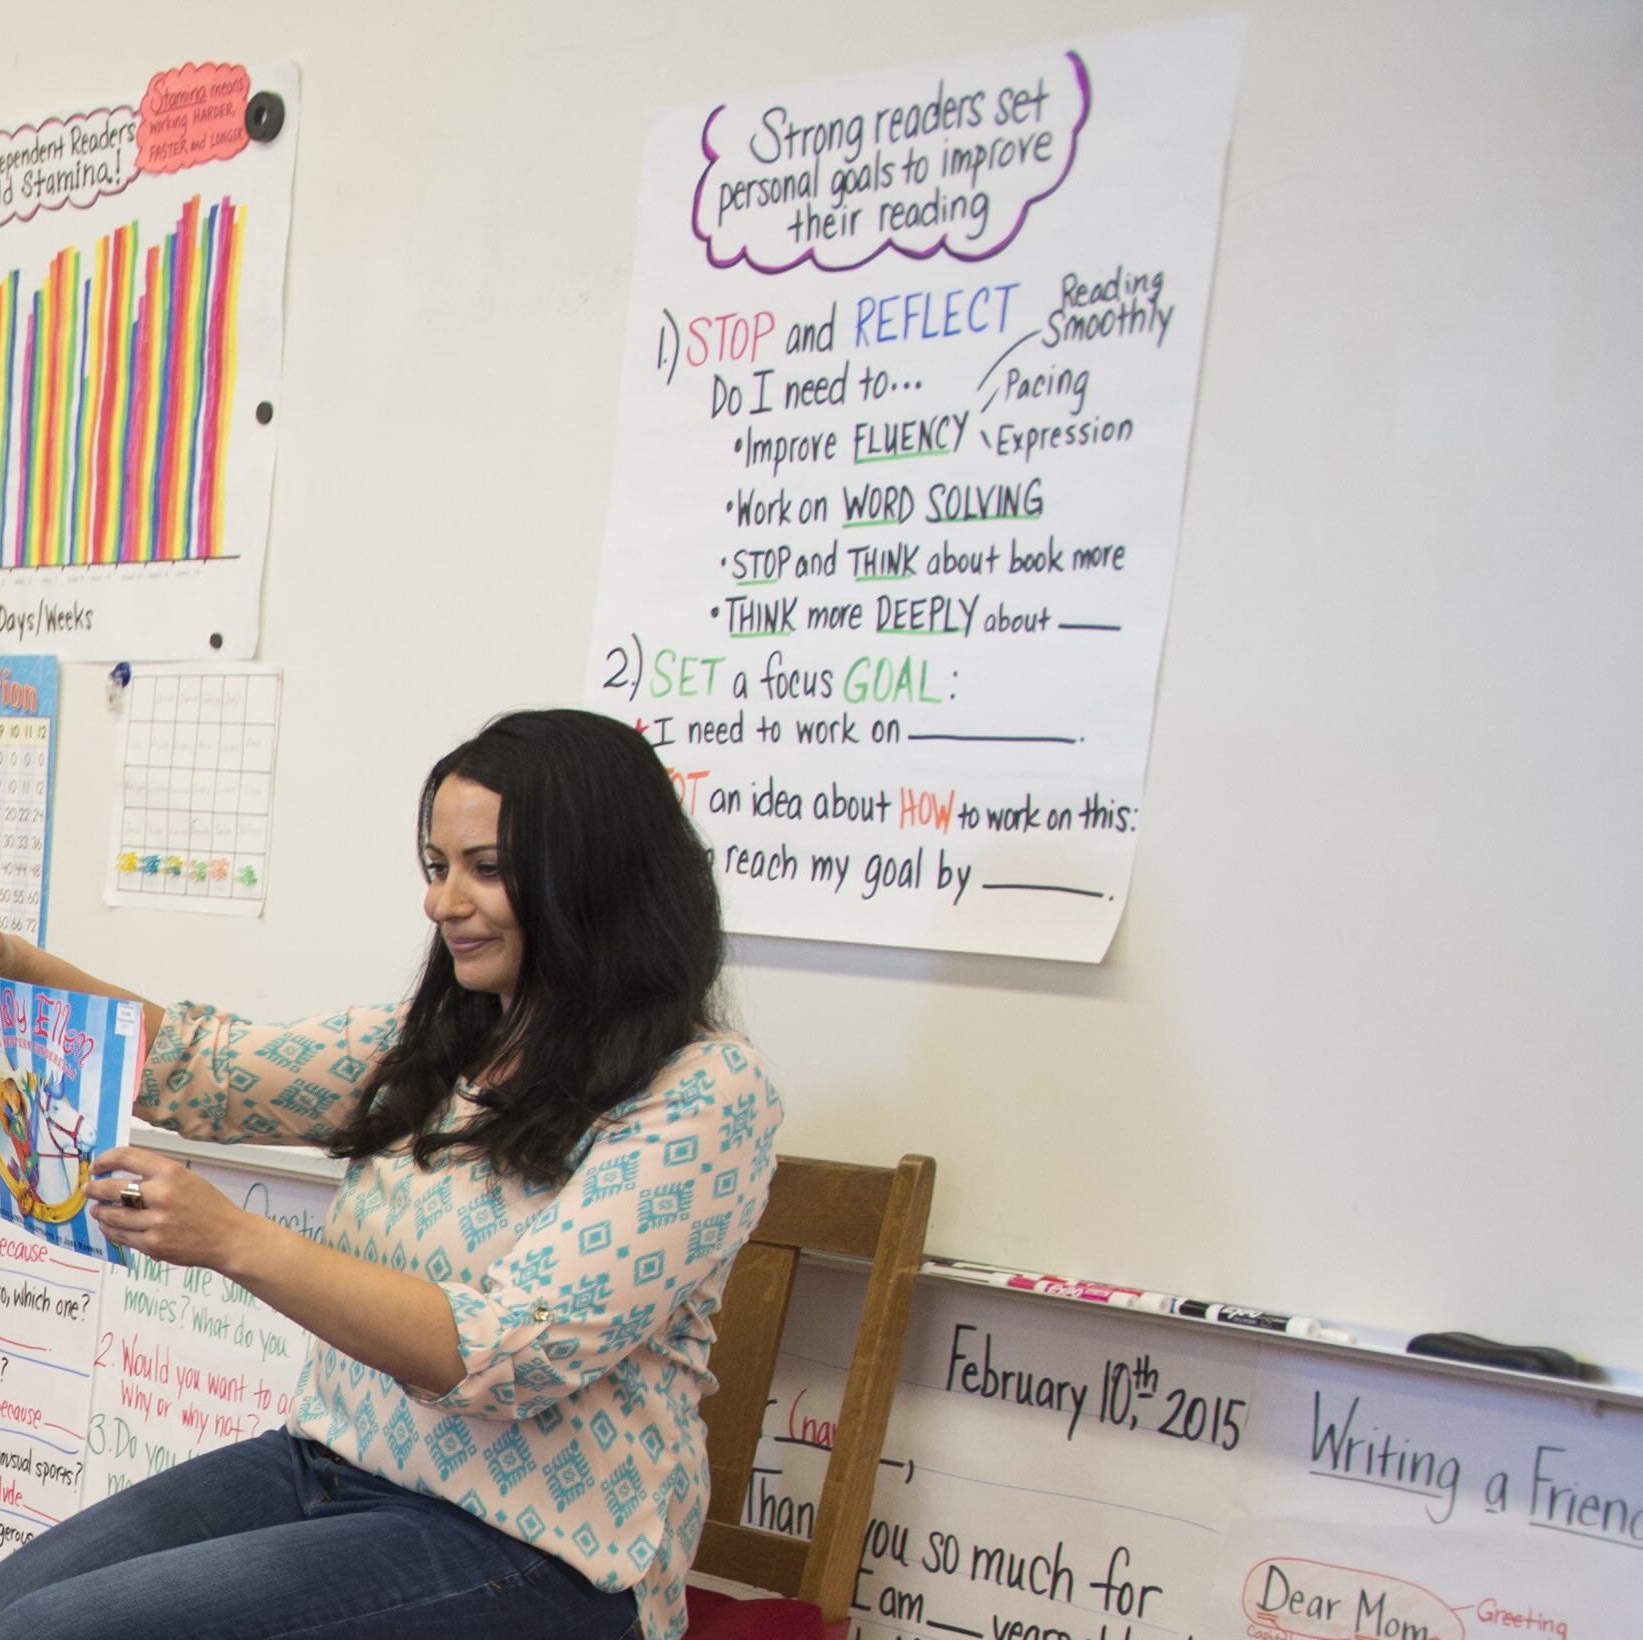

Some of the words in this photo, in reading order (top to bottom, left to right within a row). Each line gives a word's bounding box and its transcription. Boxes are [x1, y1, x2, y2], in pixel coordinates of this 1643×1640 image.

[151, 79, 206, 115] Stamina
[749, 107, 863, 165] Strong
[874, 78, 983, 144] readers
[994, 77, 1050, 124] set
[70, 121, 136, 160] Readers
[718, 158, 819, 225] personal
[830, 162, 894, 208] goals
[903, 150, 929, 186] to
[941, 130, 1053, 179] improve
[787, 199, 863, 243] their
[879, 192, 990, 240] reading
[1061, 266, 1166, 309] Reading
[686, 311, 777, 367] STOP
[786, 302, 837, 355] and
[855, 284, 1021, 347] REFLECT
[1041, 303, 1174, 348] Smoothly
[712, 374, 742, 419] Do
[749, 369, 774, 413] I
[785, 361, 848, 407] need
[1005, 366, 1089, 414] Pacing
[746, 426, 837, 477] Improve
[855, 411, 969, 459] FLUENCY
[997, 416, 1134, 459] Expression
[650, 648, 726, 698] SET
[733, 671, 748, 698] a
[759, 652, 833, 700] focus
[947, 1323, 1088, 1439] February
[1159, 1389, 1247, 1450] 2015
[1310, 1391, 1462, 1523] Writing
[1486, 1468, 1509, 1501] a
[1257, 1566, 1339, 1621] Dear
